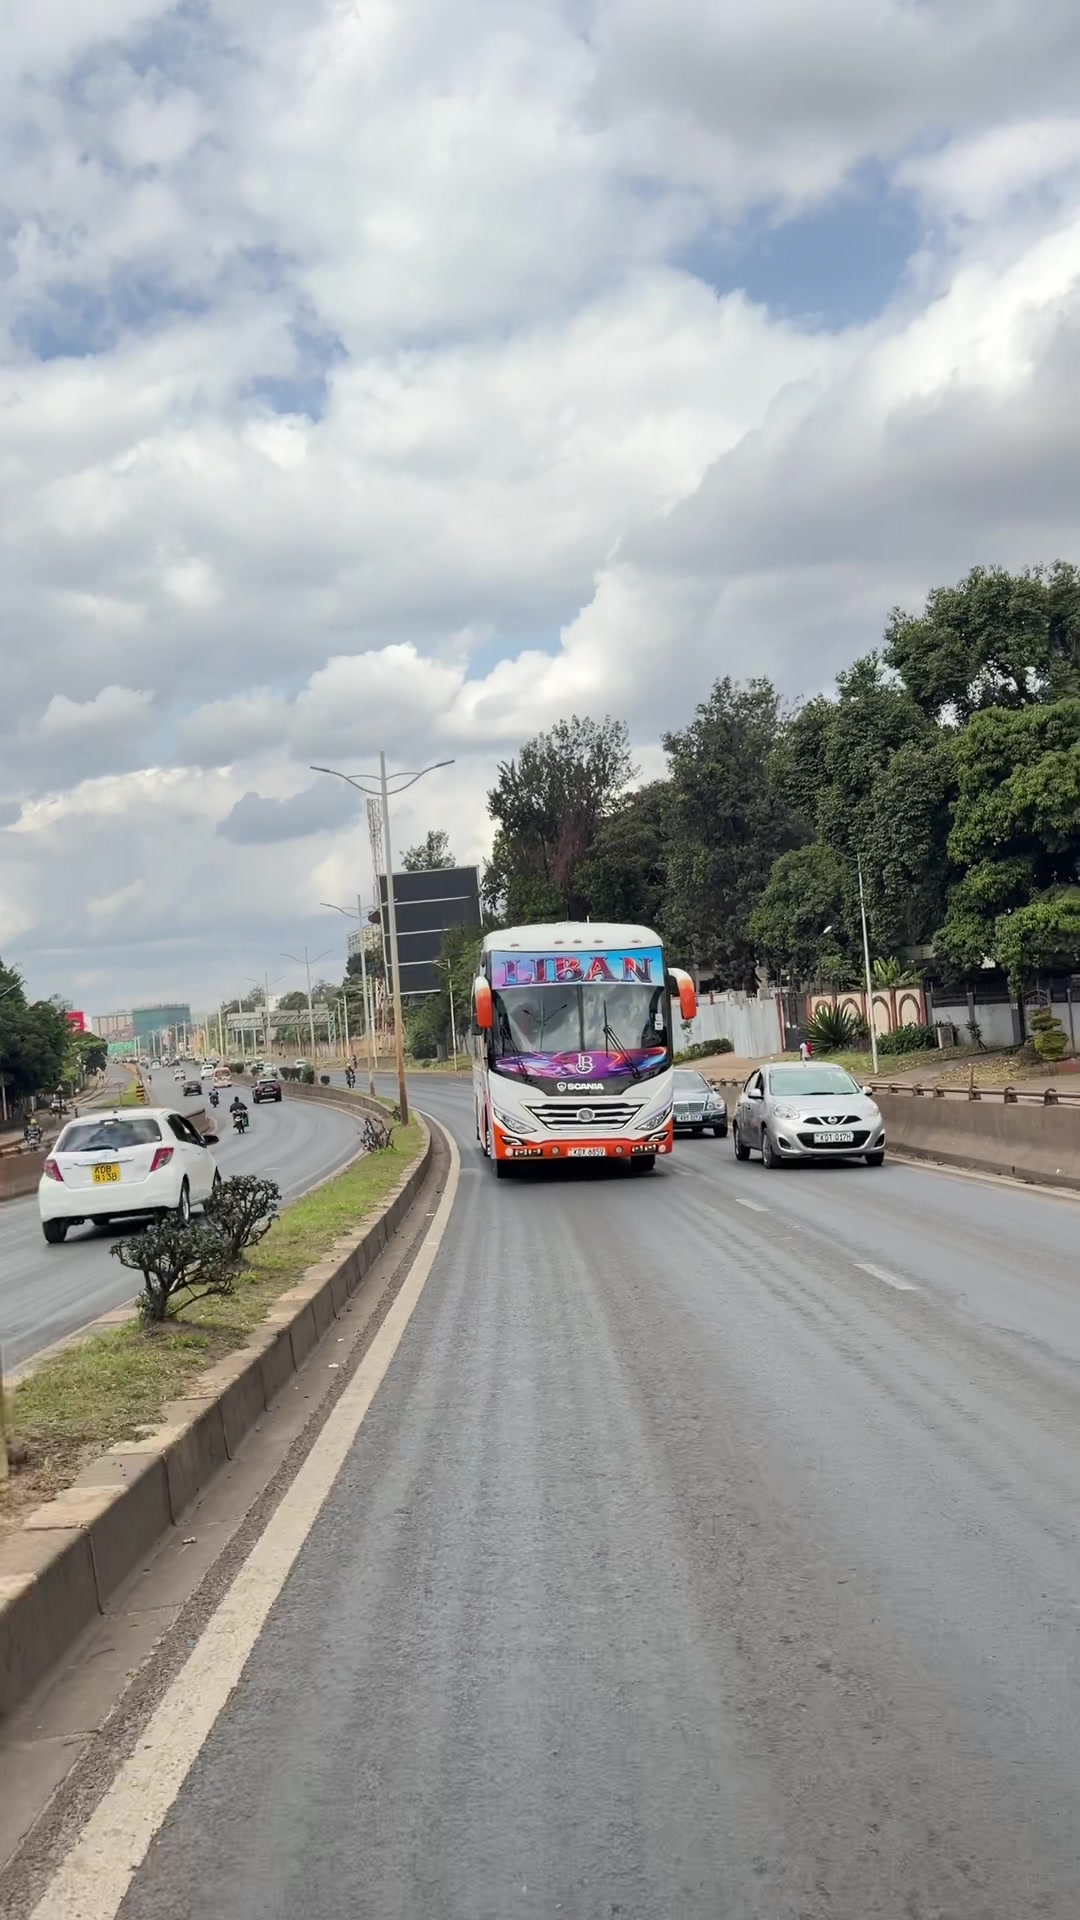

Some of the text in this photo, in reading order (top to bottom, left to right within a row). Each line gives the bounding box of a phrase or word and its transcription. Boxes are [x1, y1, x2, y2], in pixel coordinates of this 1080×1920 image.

[501, 956, 653, 986] LIBAN
[567, 1082, 605, 1091] SCANIA
[94, 1165, 112, 1175] KDB
[95, 1173, 118, 1183] 813B
